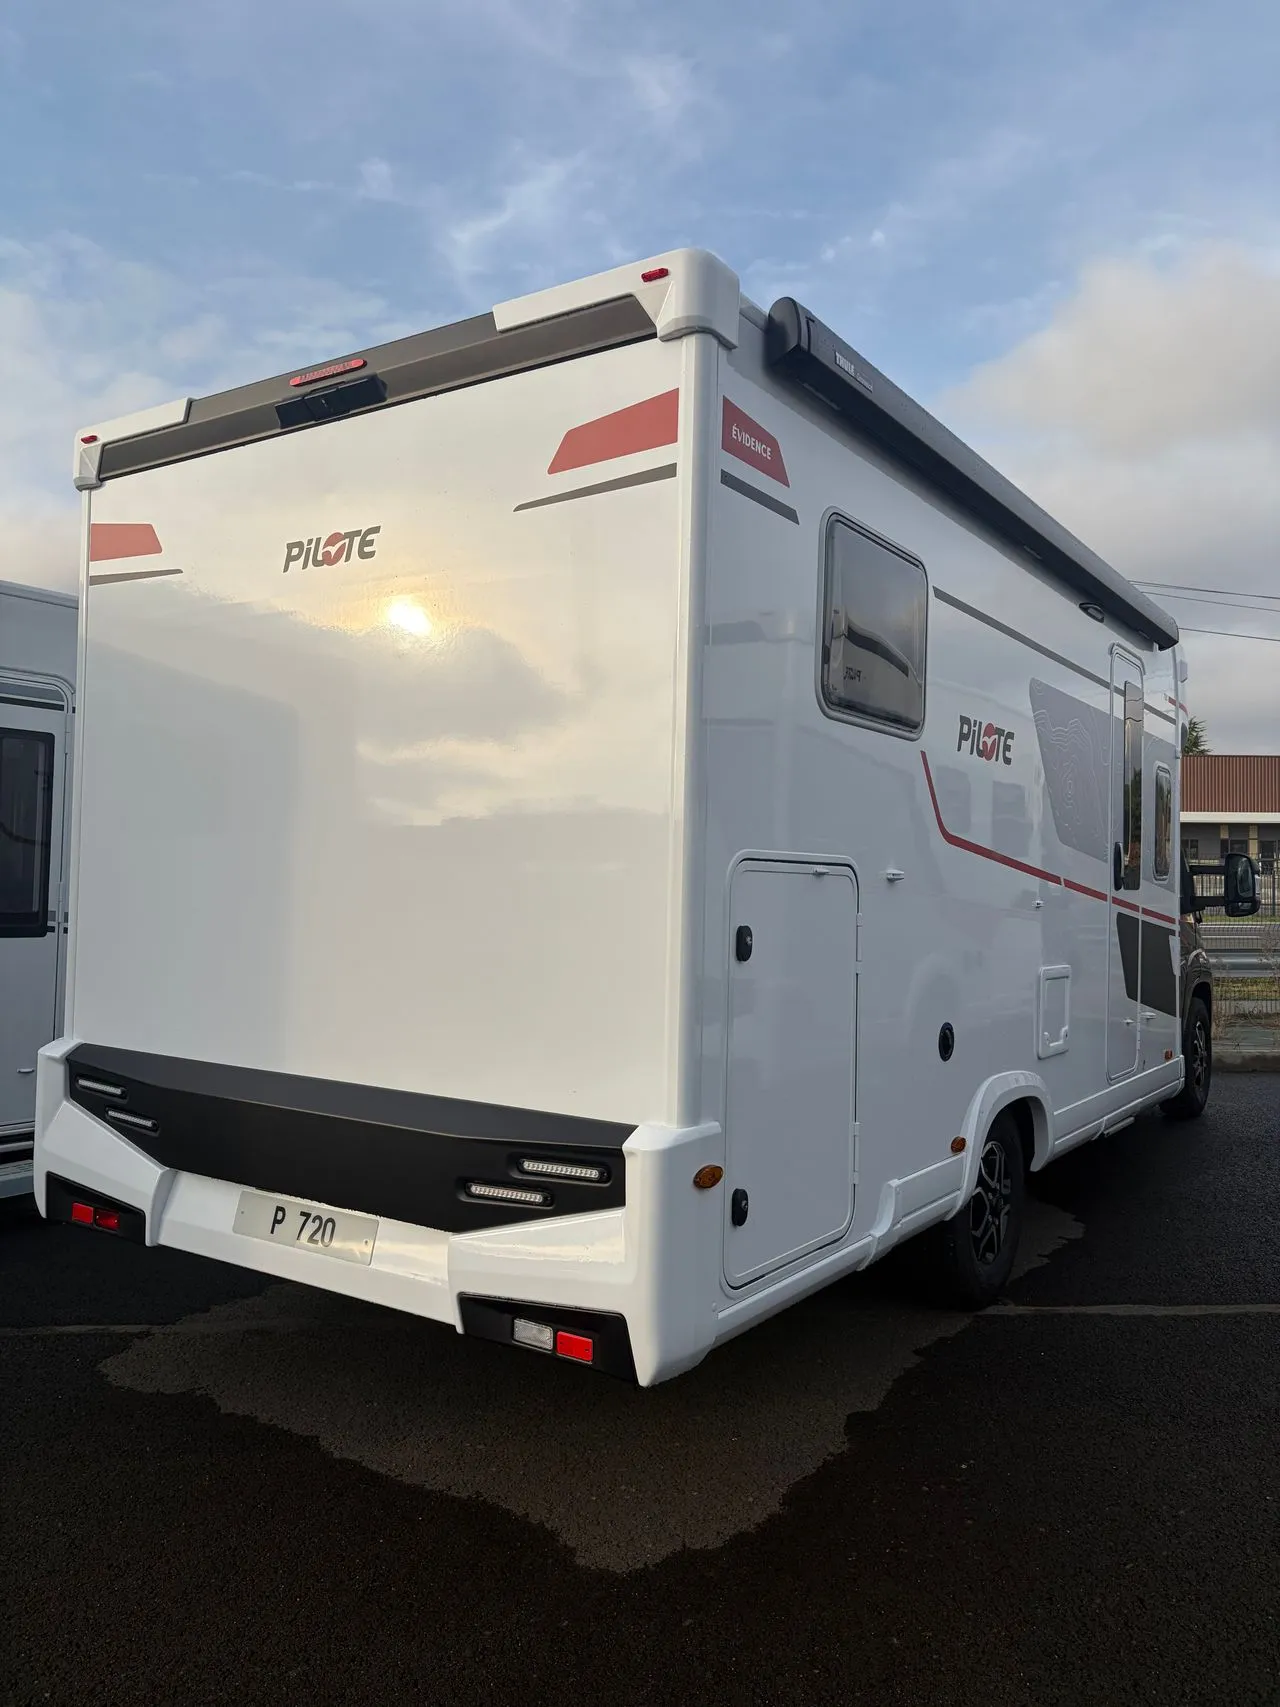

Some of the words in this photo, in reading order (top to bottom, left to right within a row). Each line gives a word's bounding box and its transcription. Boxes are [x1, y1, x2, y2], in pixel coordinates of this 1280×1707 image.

[731, 423, 772, 460] ÉVIDENCE
[270, 1205, 286, 1235] P
[296, 1210, 336, 1248] 720
